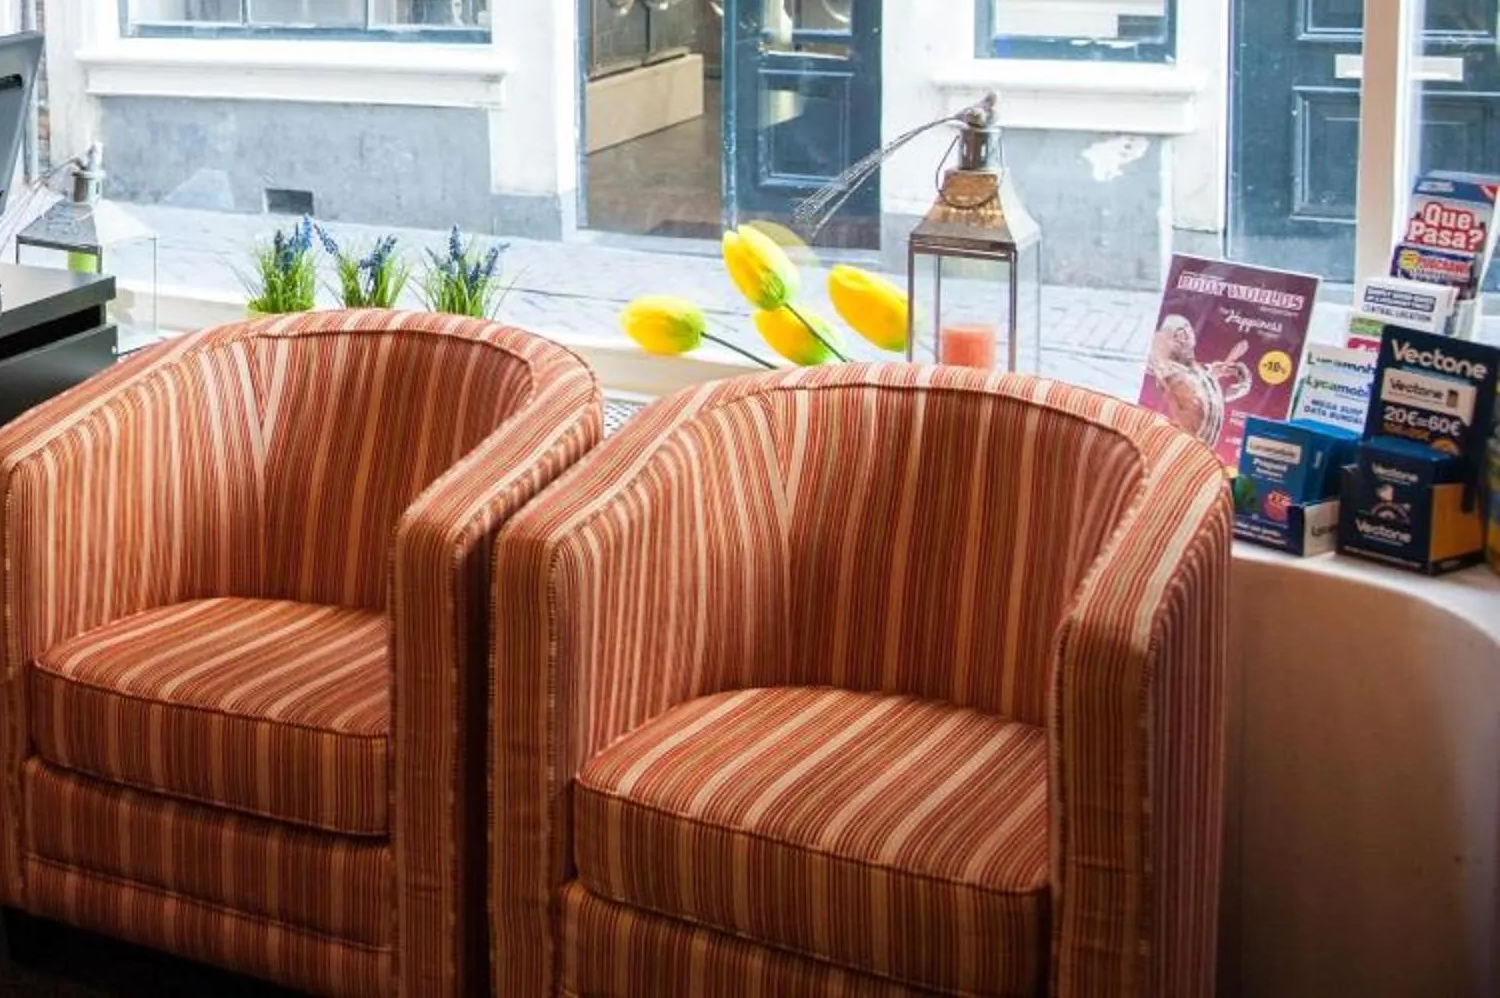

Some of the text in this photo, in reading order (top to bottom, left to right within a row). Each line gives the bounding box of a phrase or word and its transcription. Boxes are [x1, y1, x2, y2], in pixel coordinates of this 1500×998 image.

[1424, 202, 1474, 231] Que
[1407, 219, 1485, 251] Pasa?
[1391, 338, 1489, 380] Vectone
